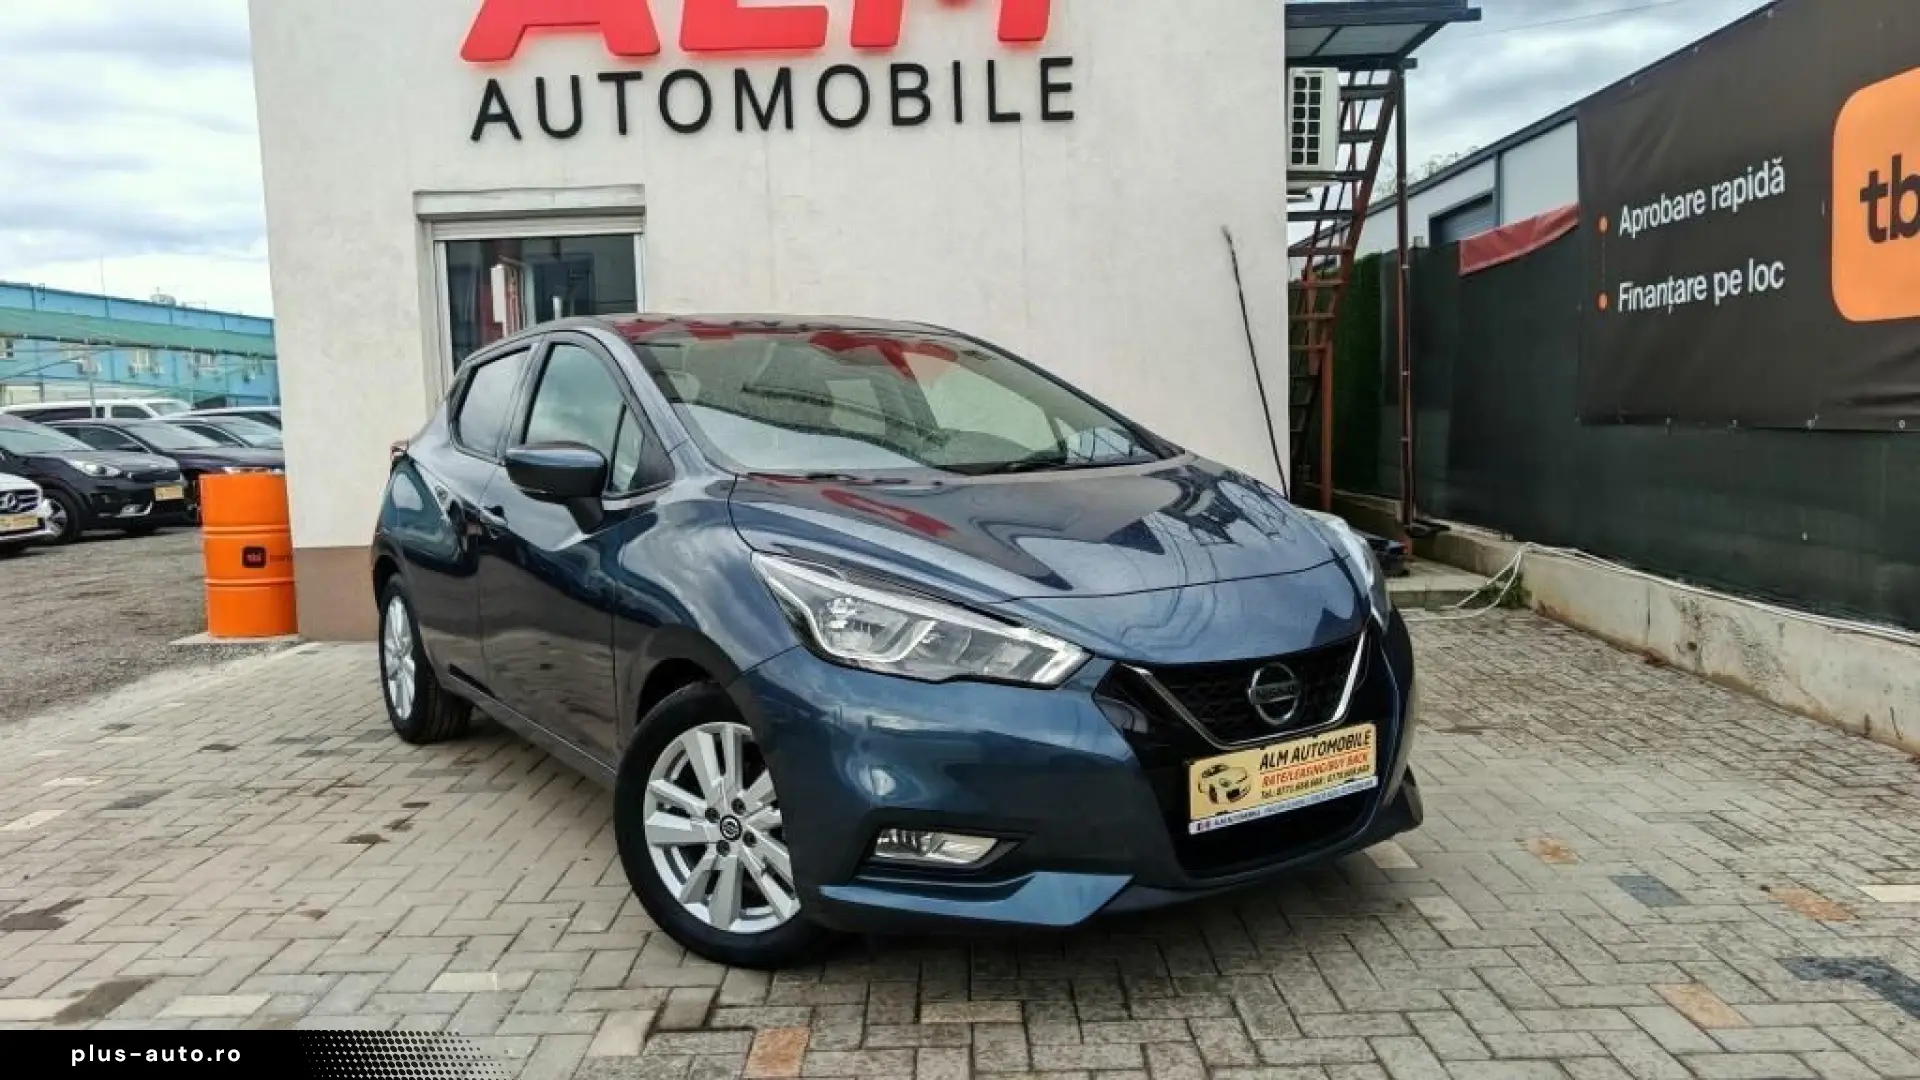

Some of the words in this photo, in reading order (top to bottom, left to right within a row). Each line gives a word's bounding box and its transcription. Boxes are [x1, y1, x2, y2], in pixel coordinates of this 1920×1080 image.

[471, 56, 1074, 142] AUTOMOBILE
[1618, 188, 1706, 239] Aprobare
[1711, 156, 1786, 213] rapidă
[1617, 276, 1708, 314] Finanțare
[1713, 270, 1742, 306] pe
[1747, 257, 1786, 293] loc
[1260, 749, 1289, 770] ALM
[1291, 729, 1372, 763] AUTOMOBILE
